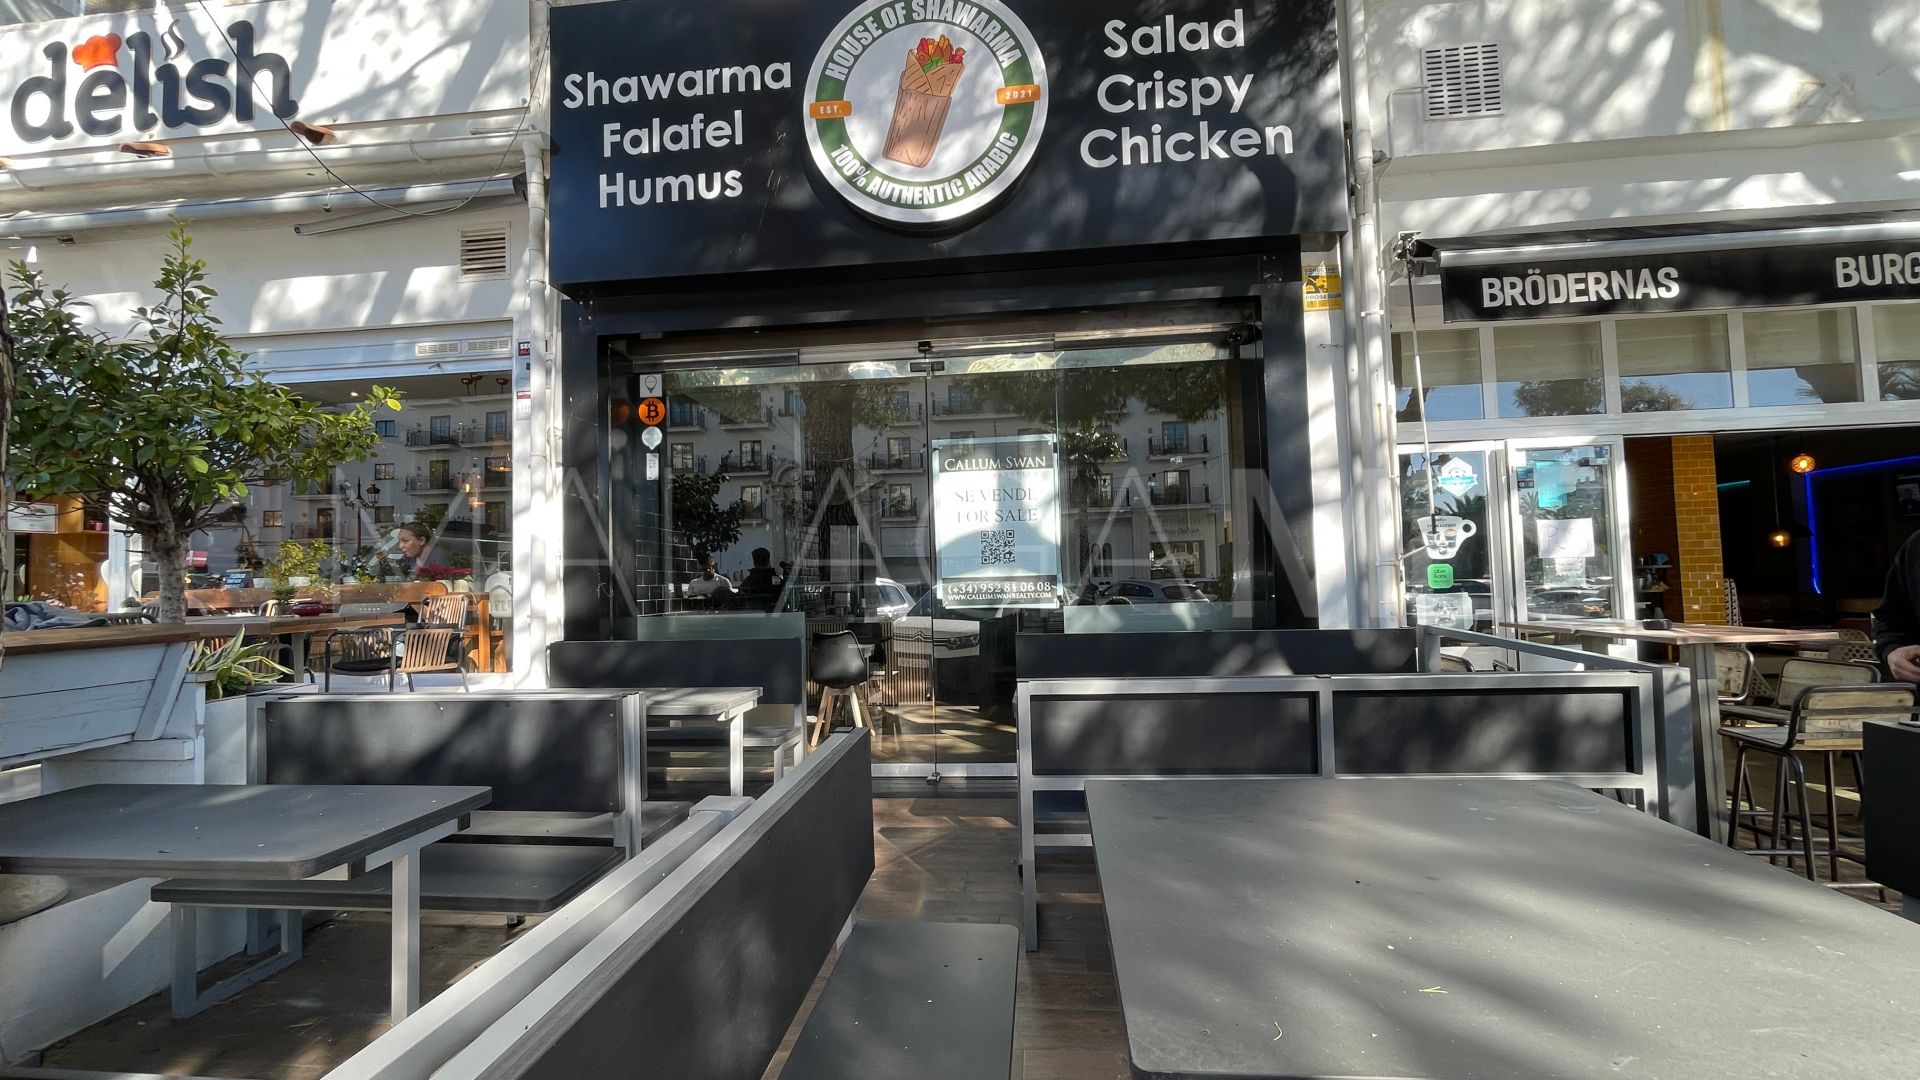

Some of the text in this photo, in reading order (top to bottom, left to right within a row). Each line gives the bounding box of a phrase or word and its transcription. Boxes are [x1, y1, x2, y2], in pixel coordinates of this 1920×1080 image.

[824, 0, 1022, 81] HOUSE OF SHAWARMA
[1103, 8, 1245, 58] Salad
[11, 20, 299, 144] delish
[563, 61, 792, 109] Shawarma
[1005, 89, 1032, 100] 2021
[1097, 70, 1254, 116] Crispy
[603, 109, 743, 157] Falafel
[819, 105, 842, 115] EST.
[1080, 121, 1294, 168] Chicken
[600, 169, 743, 208] Humus
[830, 132, 1019, 206] 100% AUTHENTIC ARABIC
[1481, 251, 1920, 308] BRÖDERNAS BURG
[944, 456, 1046, 470] CALLUM SWAN
[957, 509, 1038, 523] FOR SALE
[948, 581, 1051, 595] (+34) 952 81 06 08
